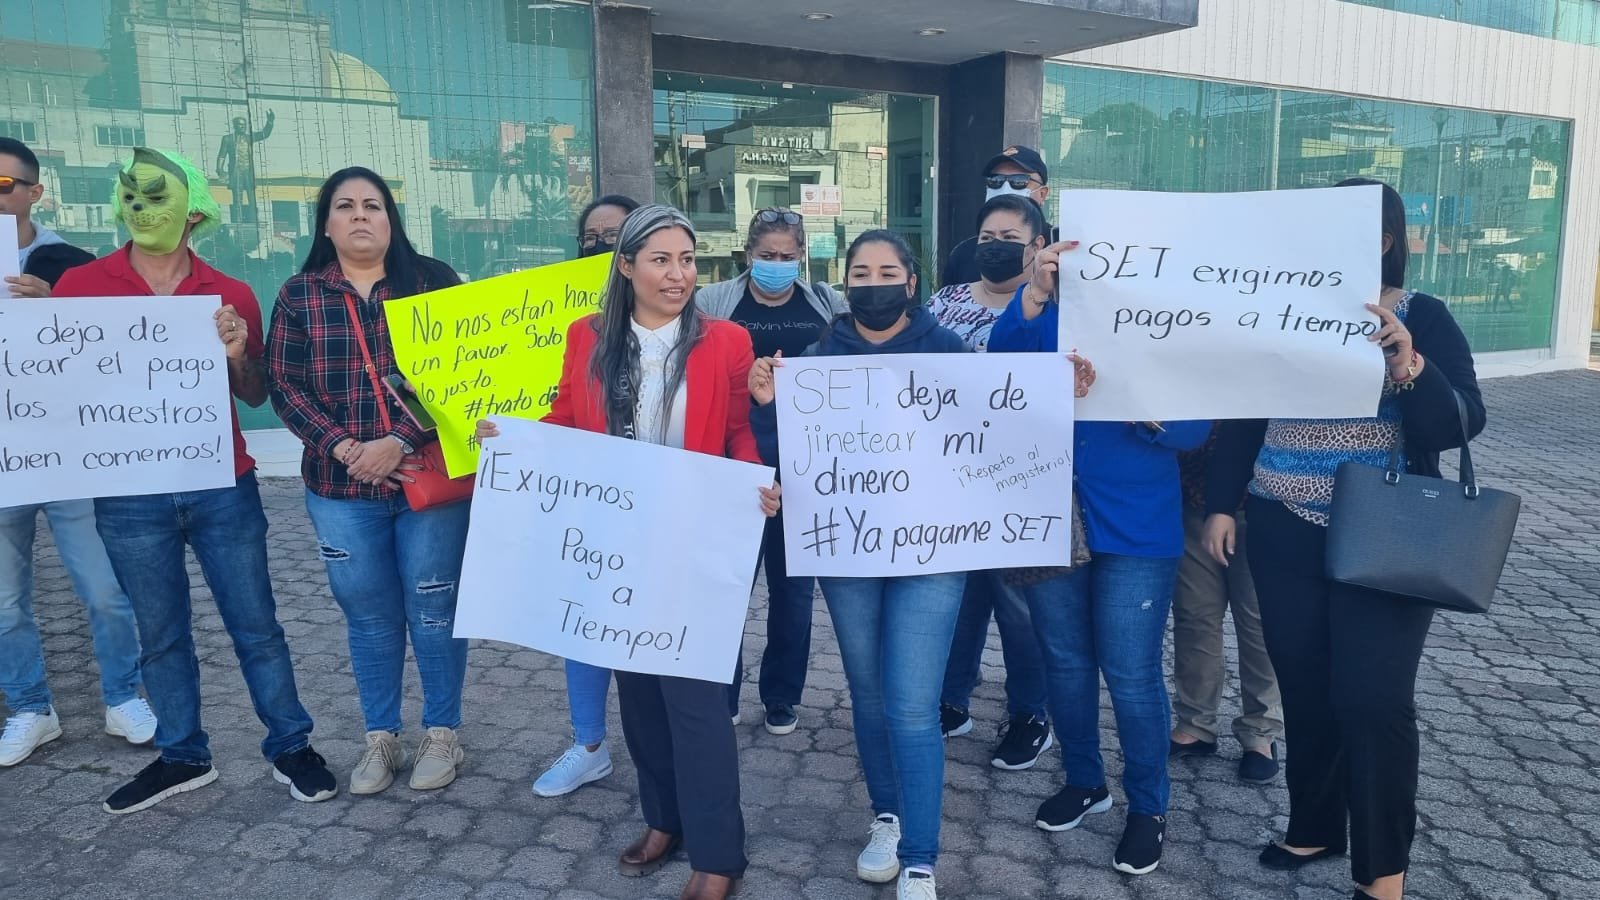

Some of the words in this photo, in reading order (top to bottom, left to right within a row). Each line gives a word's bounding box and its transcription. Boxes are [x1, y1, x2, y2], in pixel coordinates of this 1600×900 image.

[1079, 241, 1172, 281] SET
[1192, 262, 1344, 295] exigimos
[37, 313, 105, 356] deja
[128, 315, 169, 343] de
[411, 300, 443, 345] No
[455, 312, 492, 339] nos
[501, 289, 554, 327] estan
[1113, 307, 1213, 340] pagos
[1237, 310, 1261, 329] a
[1278, 303, 1378, 346] tiempo
[0, 350, 71, 378] tear
[95, 351, 122, 375] el
[147, 357, 216, 390] pago
[411, 356, 441, 376] un
[525, 324, 563, 349] Solo
[6, 388, 47, 421] los
[78, 398, 218, 427] maestros
[421, 382, 436, 403] lo
[463, 388, 532, 420] #trato
[897, 370, 960, 422] deja
[988, 371, 1028, 411] de
[0, 446, 61, 473] bien
[82, 434, 222, 471] comemos!
[793, 420, 917, 476] jinetear
[943, 420, 991, 457] mi
[1027, 444, 1041, 462] al
[814, 456, 911, 496] dinero
[995, 448, 1073, 493] magisterio!
[560, 526, 625, 581] Pago
[891, 519, 992, 564] pagame
[1001, 512, 1063, 545] SET
[611, 585, 634, 606] a
[558, 598, 688, 661] Tiempo!
